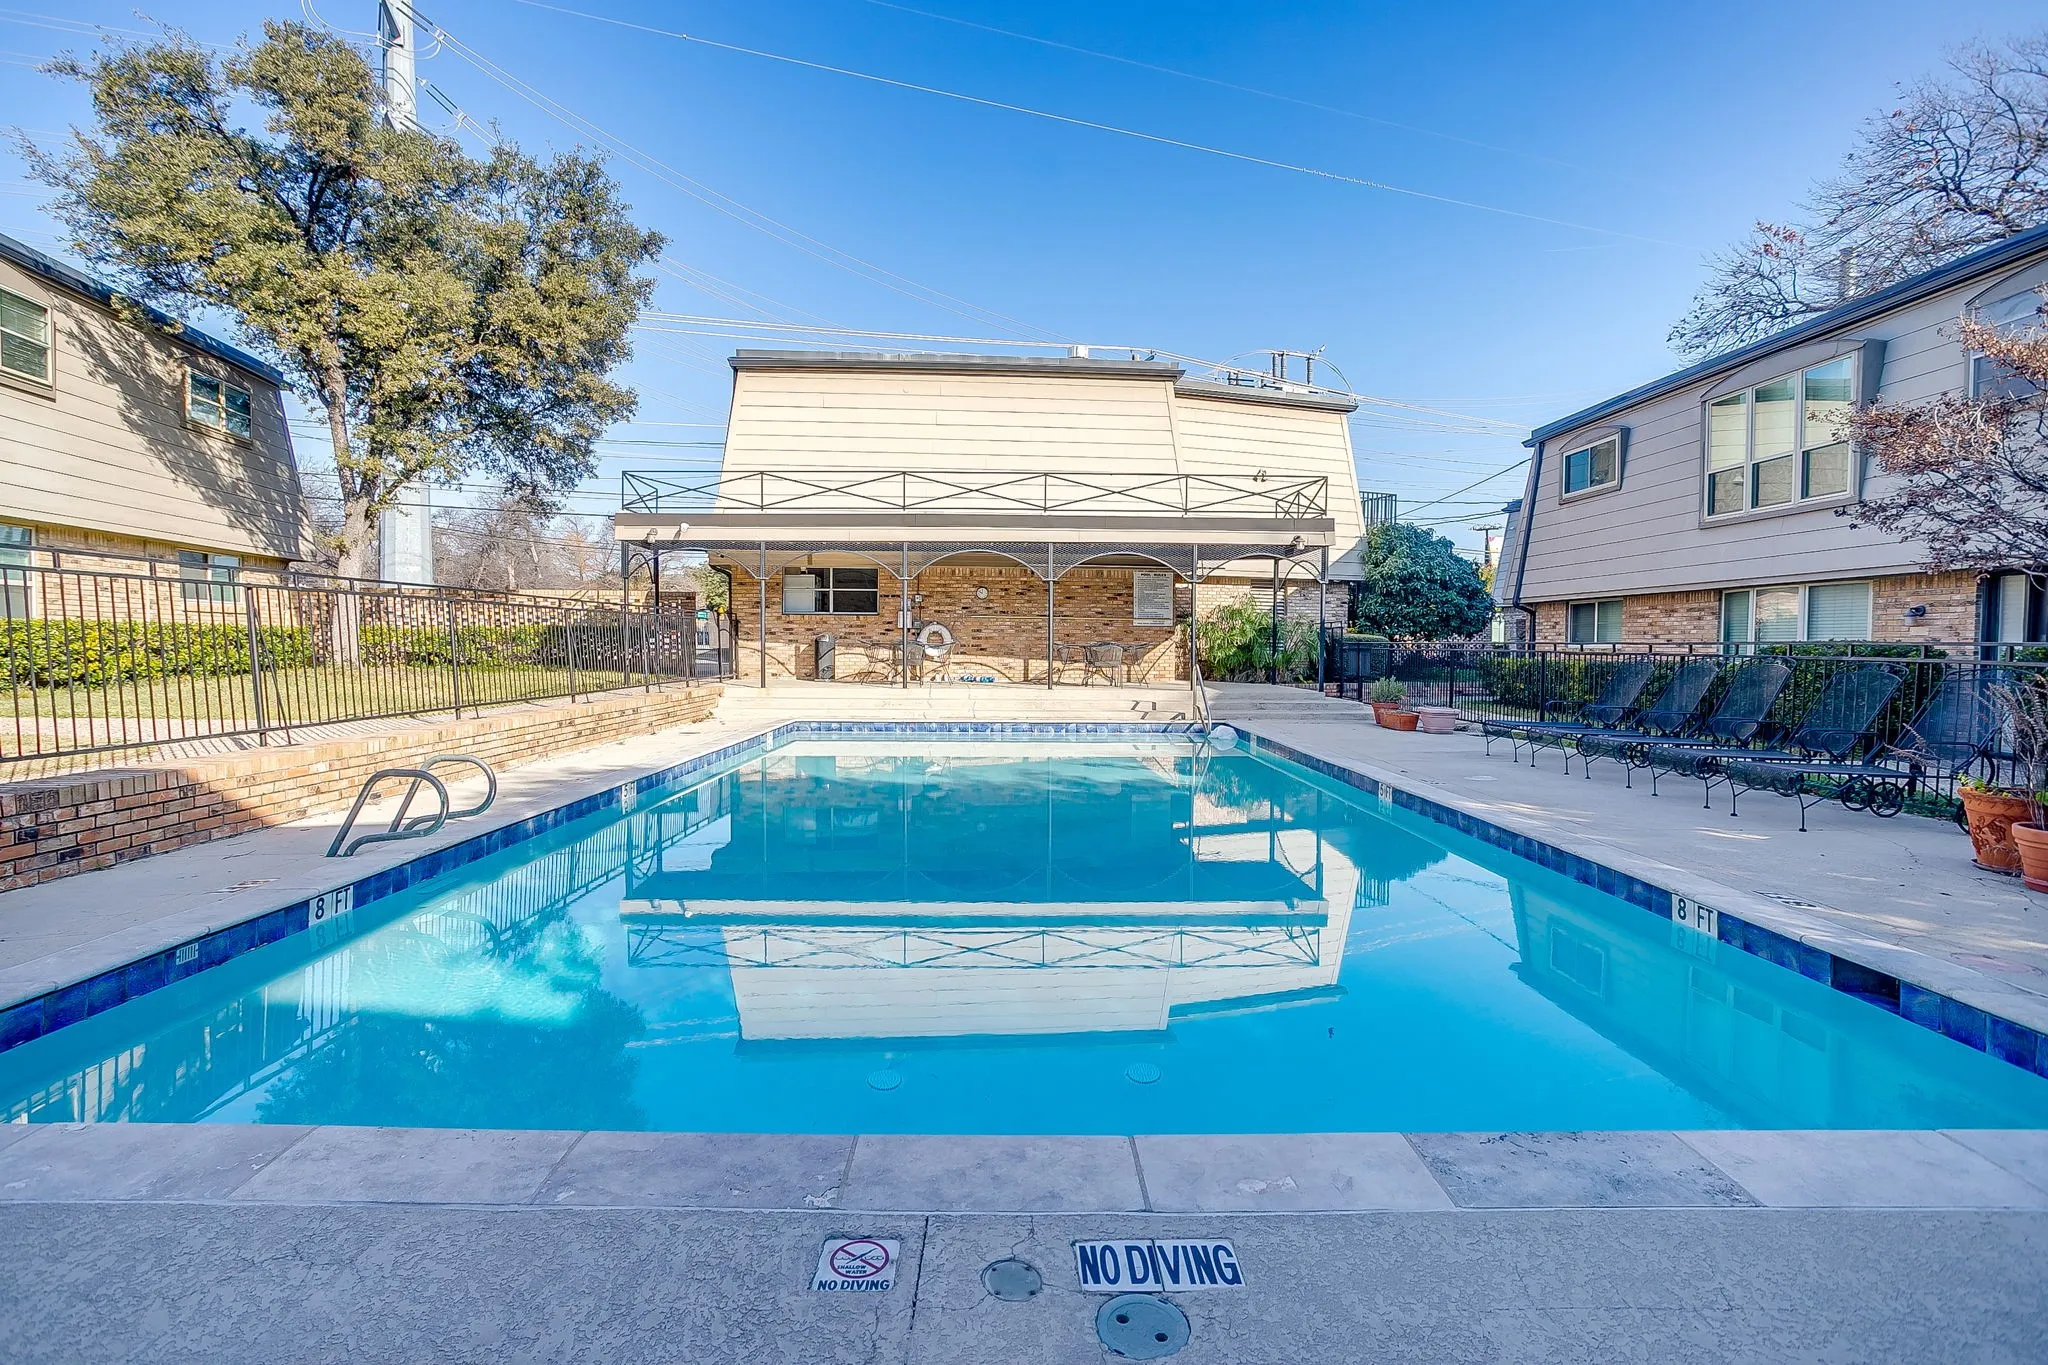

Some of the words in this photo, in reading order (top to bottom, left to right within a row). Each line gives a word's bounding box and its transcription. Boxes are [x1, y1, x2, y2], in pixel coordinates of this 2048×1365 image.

[315, 898, 325, 920] 8
[334, 888, 351, 914] FT
[1677, 898, 1687, 921] 8
[1697, 907, 1713, 933] FT
[1078, 1244, 1120, 1285] NO
[1124, 1244, 1242, 1285] DIVING
[817, 1280, 838, 1291] NO
[840, 1280, 890, 1291] DIVING
